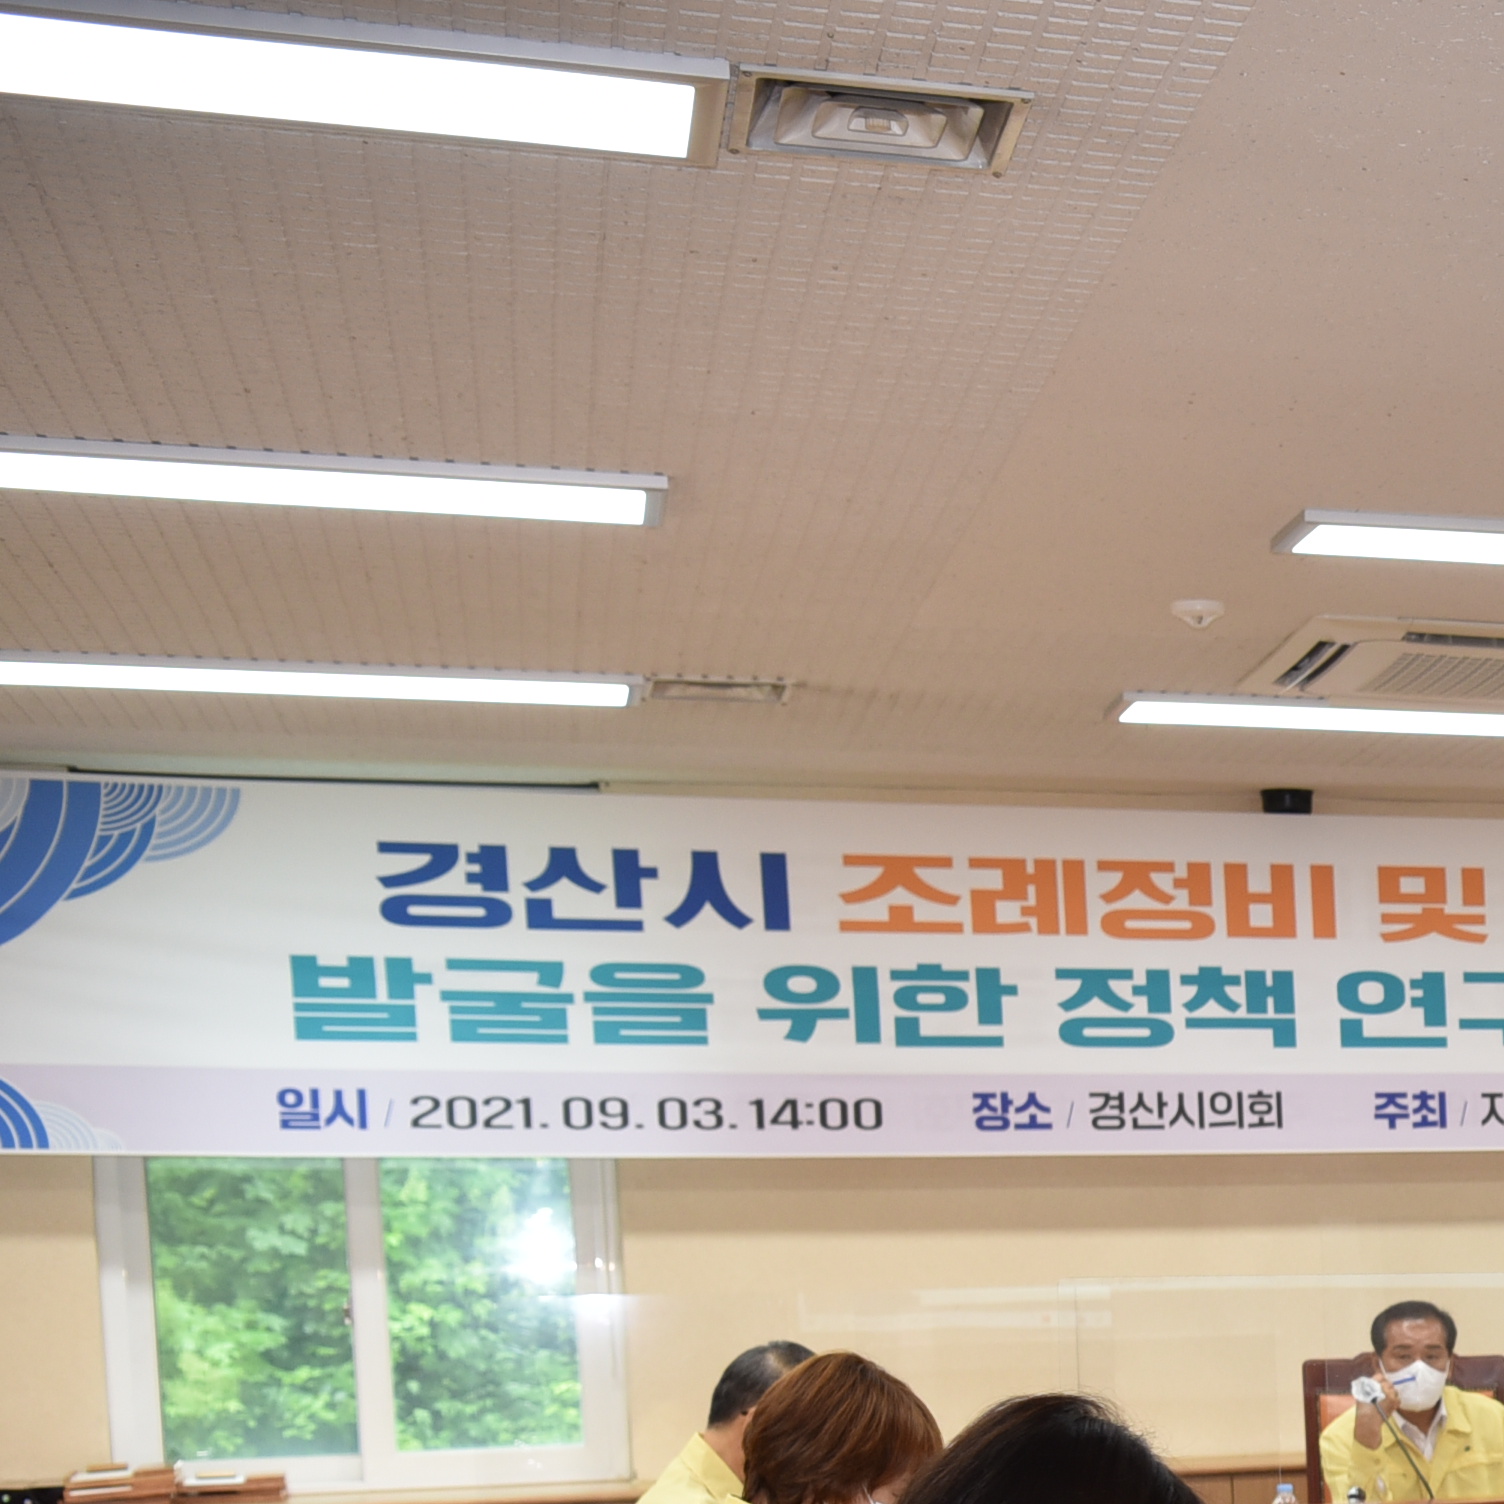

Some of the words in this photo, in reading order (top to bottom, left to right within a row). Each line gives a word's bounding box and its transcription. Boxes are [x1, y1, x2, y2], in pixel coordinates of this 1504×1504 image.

[376, 841, 791, 932] 경산시
[839, 853, 1336, 940] 조례정비
[1377, 865, 1487, 943] 및
[289, 954, 715, 1046] 발굴을
[756, 963, 1019, 1048] 위한
[1054, 966, 1297, 1049] 정책
[276, 1088, 368, 1130] 일시
[972, 1091, 1053, 1132] 장소
[1088, 1090, 1284, 1131] 경산시의회
[1373, 1090, 1448, 1130] 주최
